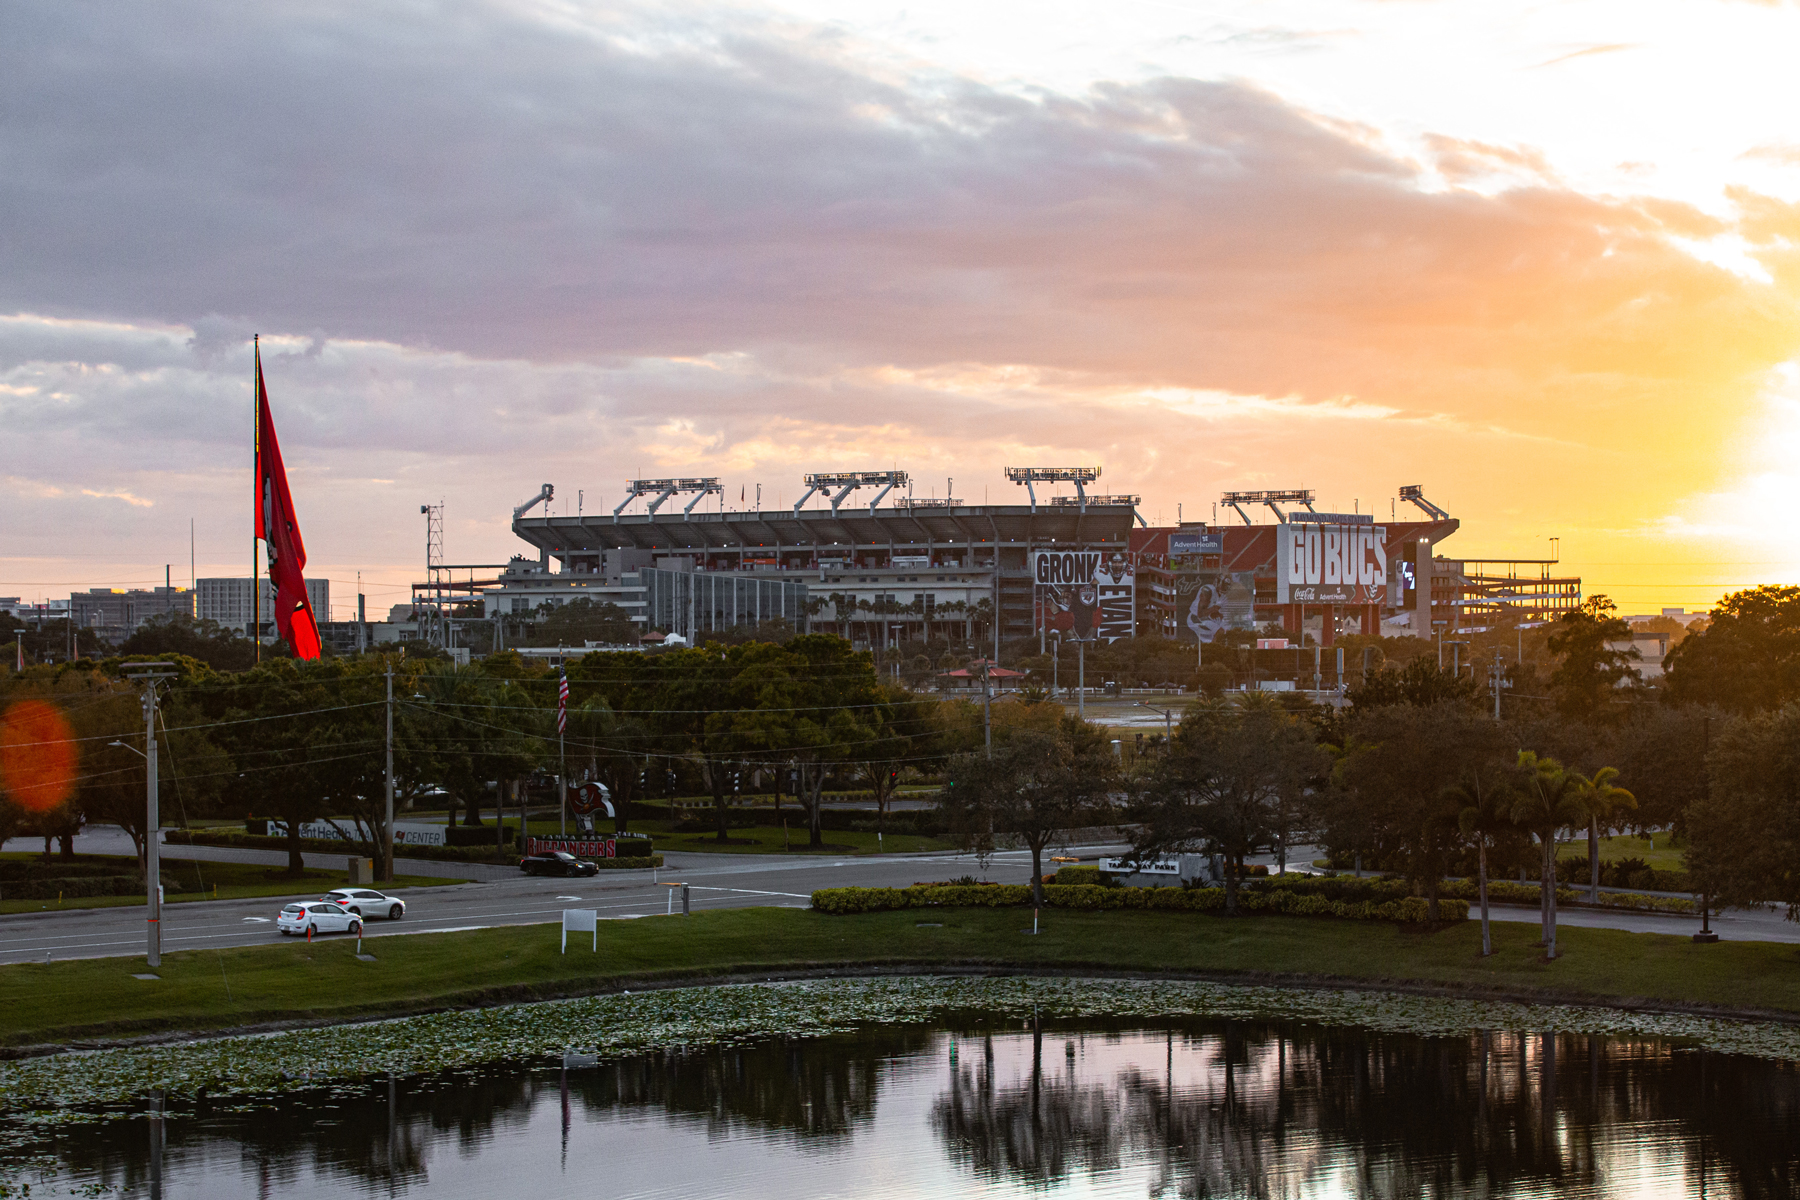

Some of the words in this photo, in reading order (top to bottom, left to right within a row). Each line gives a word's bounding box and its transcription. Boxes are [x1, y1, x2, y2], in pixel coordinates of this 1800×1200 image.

[1295, 513, 1326, 522] RAYMOND
[1289, 523, 1322, 585] GO
[1324, 524, 1387, 586] BUCS
[1036, 553, 1100, 583] GRONK
[1099, 585, 1133, 639] EVAN
[405, 831, 440, 844] CENTER
[527, 837, 616, 858] BUCCANEERS
